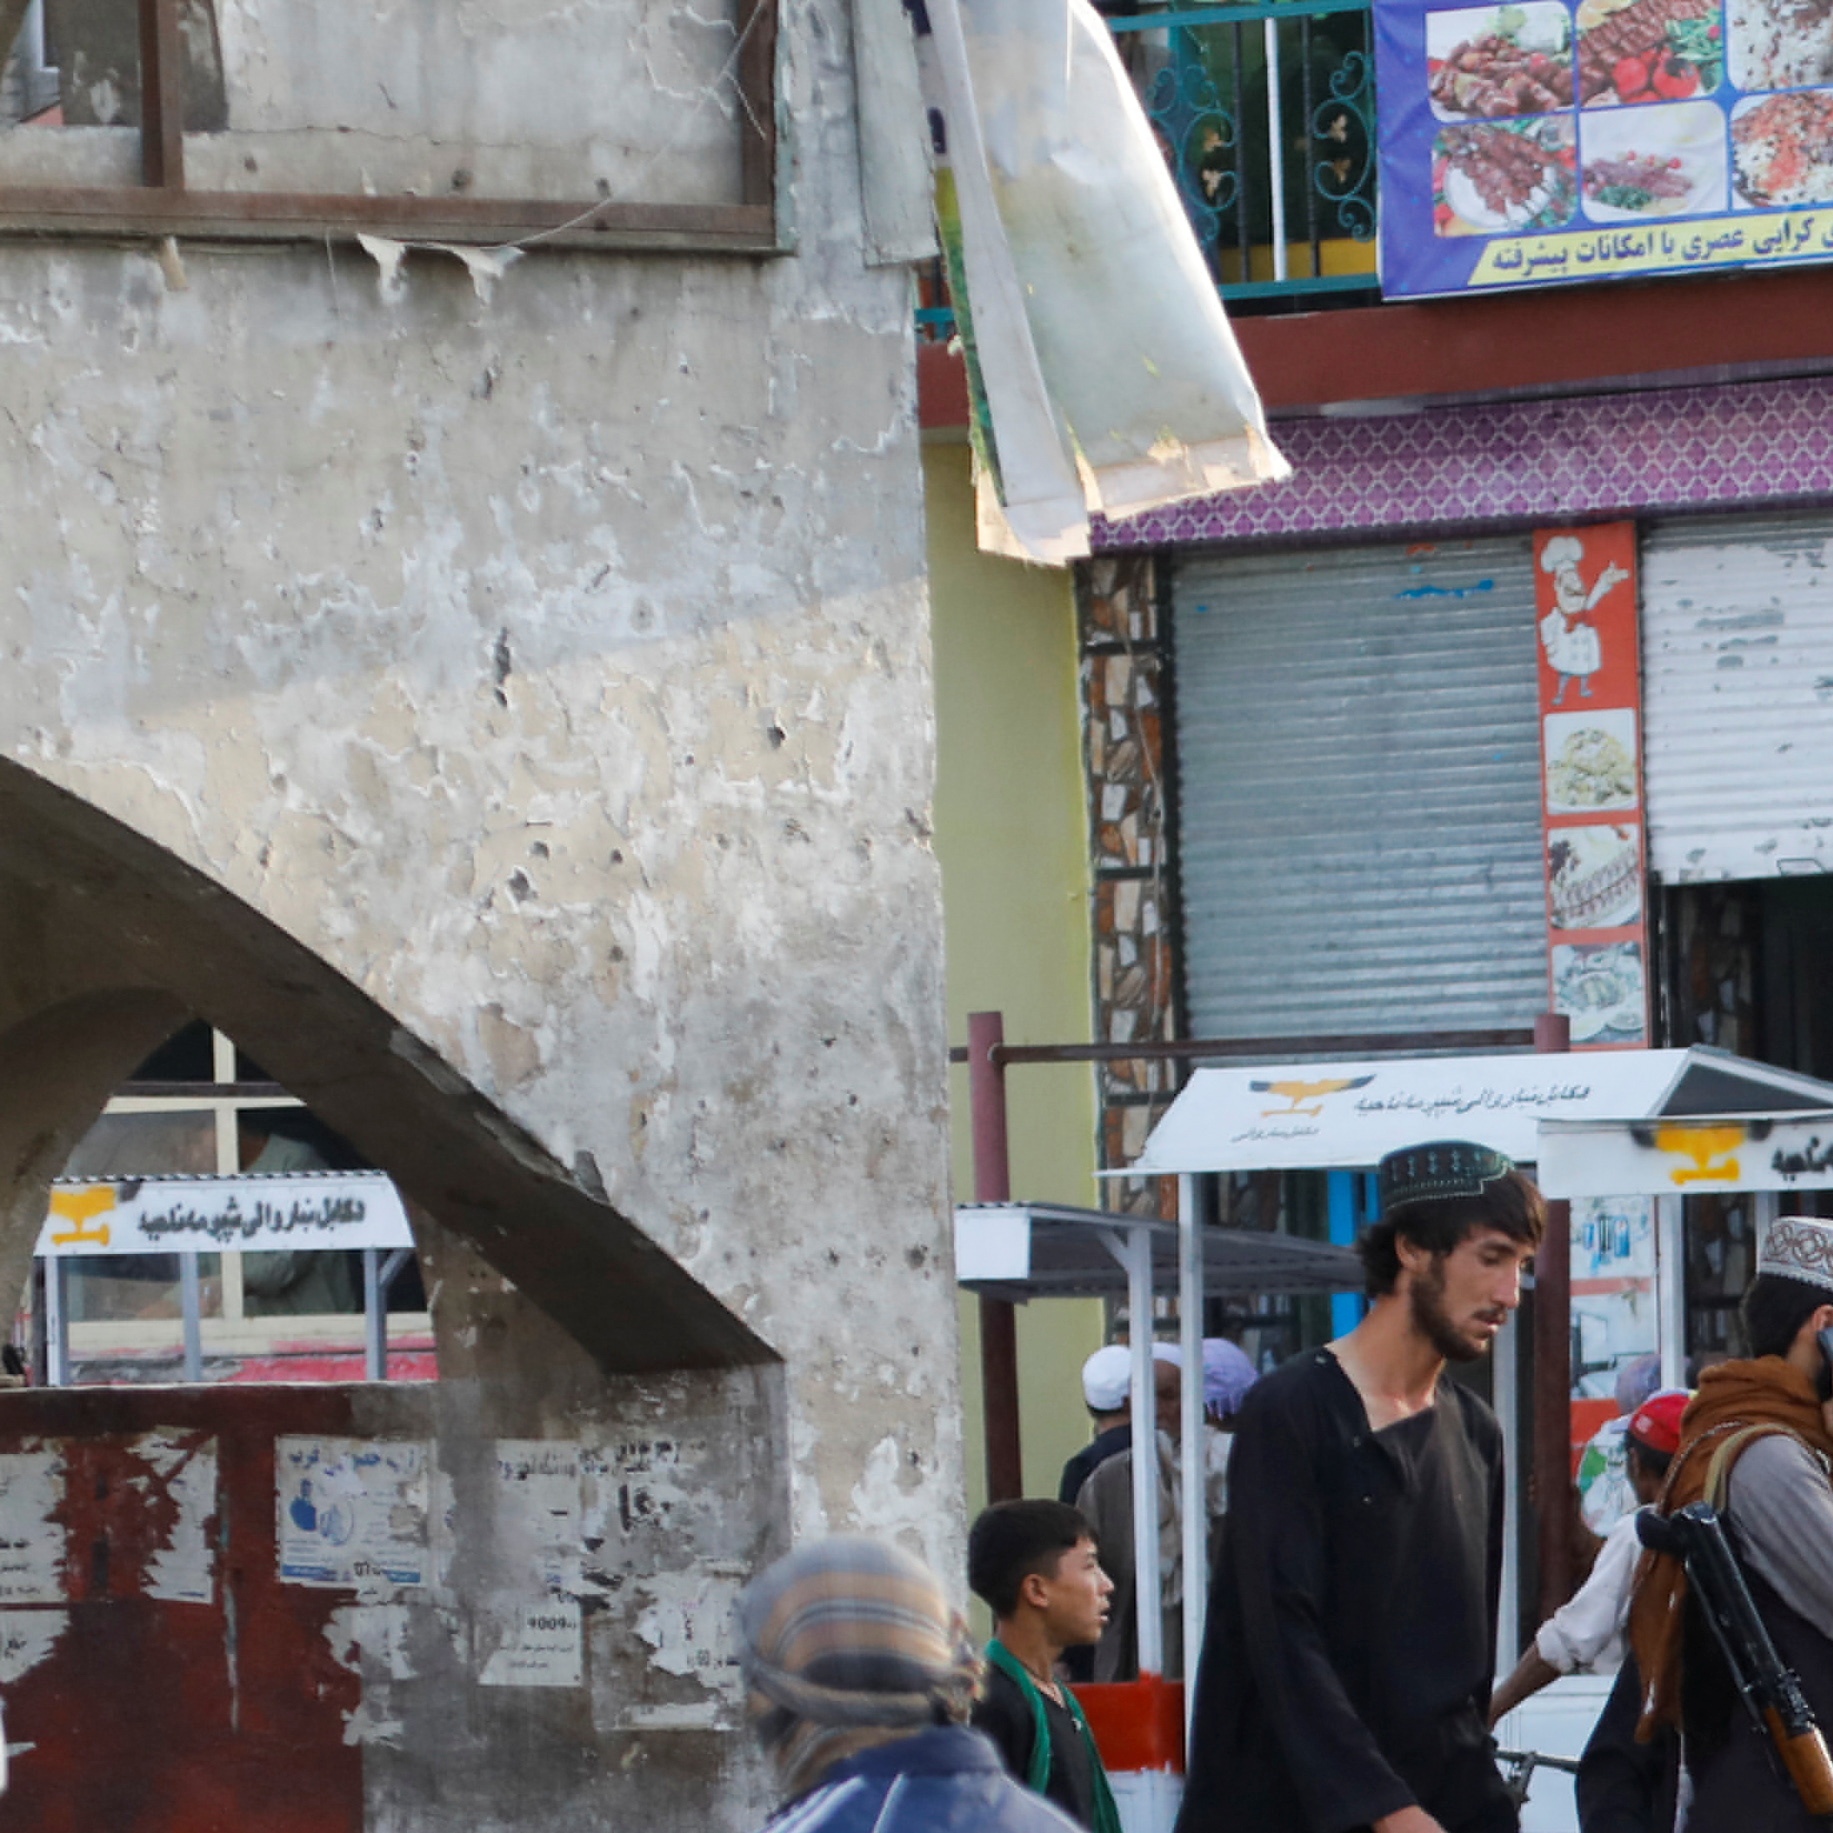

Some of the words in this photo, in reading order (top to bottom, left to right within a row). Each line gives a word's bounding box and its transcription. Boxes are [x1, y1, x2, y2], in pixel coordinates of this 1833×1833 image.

[1577, 231, 1653, 264] امکانات
[1661, 227, 1675, 254] با
[1683, 230, 1744, 261] عصری
[1492, 240, 1568, 276] پیشرفته
